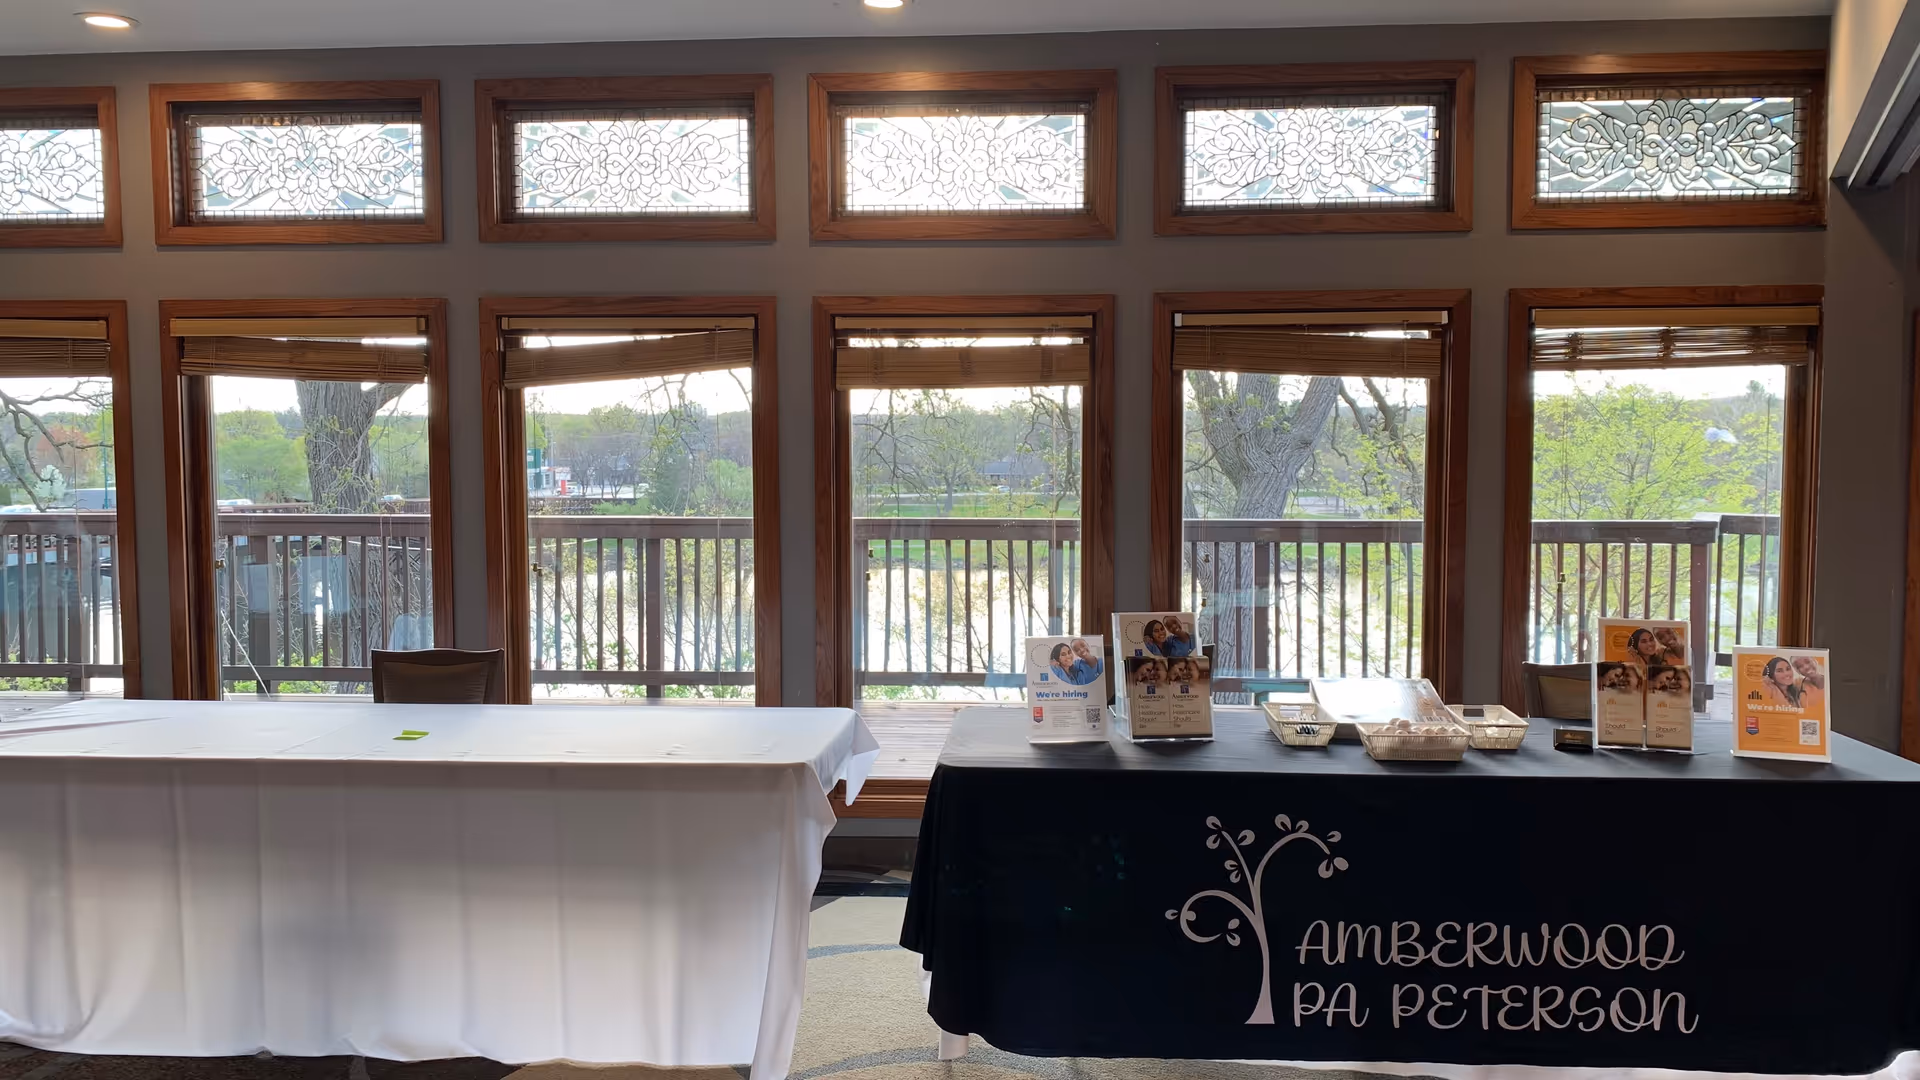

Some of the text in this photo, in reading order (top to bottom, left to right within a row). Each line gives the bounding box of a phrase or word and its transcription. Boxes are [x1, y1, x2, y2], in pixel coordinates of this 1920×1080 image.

[1062, 690, 1088, 699] hiring
[1747, 703, 1774, 711] We're
[1775, 704, 1805, 714] hiring
[1295, 919, 1685, 971] AMBERWOOD
[1293, 981, 1700, 1034] PA PETERSON
